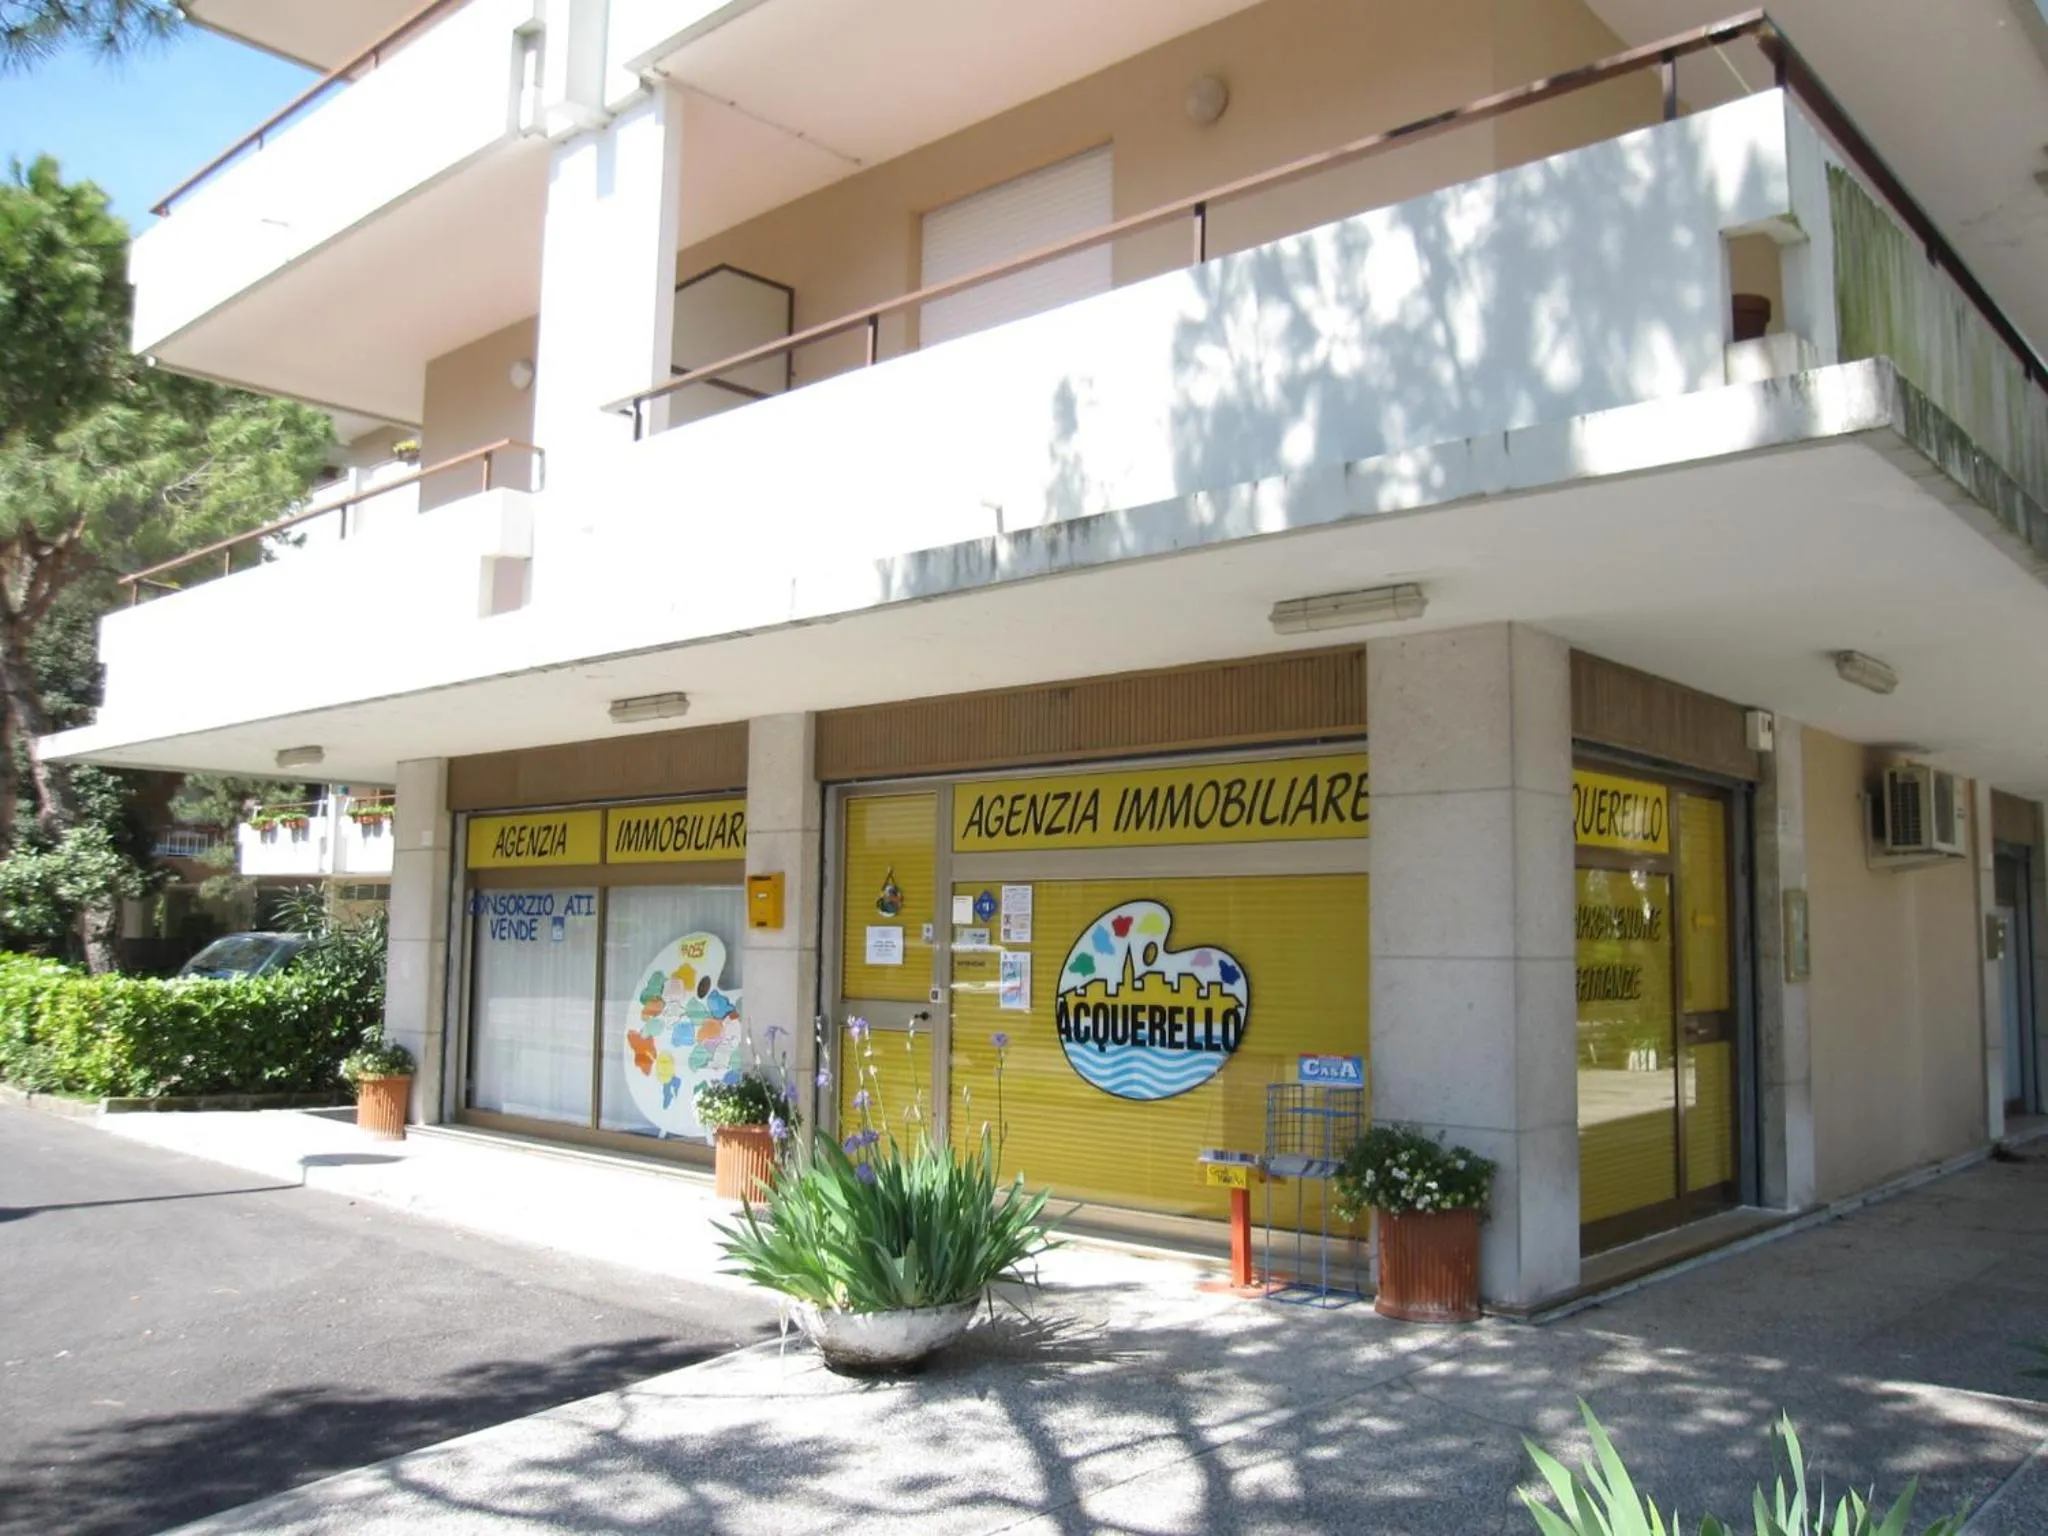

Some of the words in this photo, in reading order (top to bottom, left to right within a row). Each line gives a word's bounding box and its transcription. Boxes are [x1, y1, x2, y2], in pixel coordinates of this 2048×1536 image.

[962, 788, 1100, 840] AGENZIA
[1113, 772, 1370, 833] IMMOBILIARE
[493, 822, 568, 858] AGENZIA
[614, 811, 747, 853] IMMOBILIAR
[490, 918, 539, 940] VENDE
[1057, 996, 1243, 1053] ACQUERELLO
